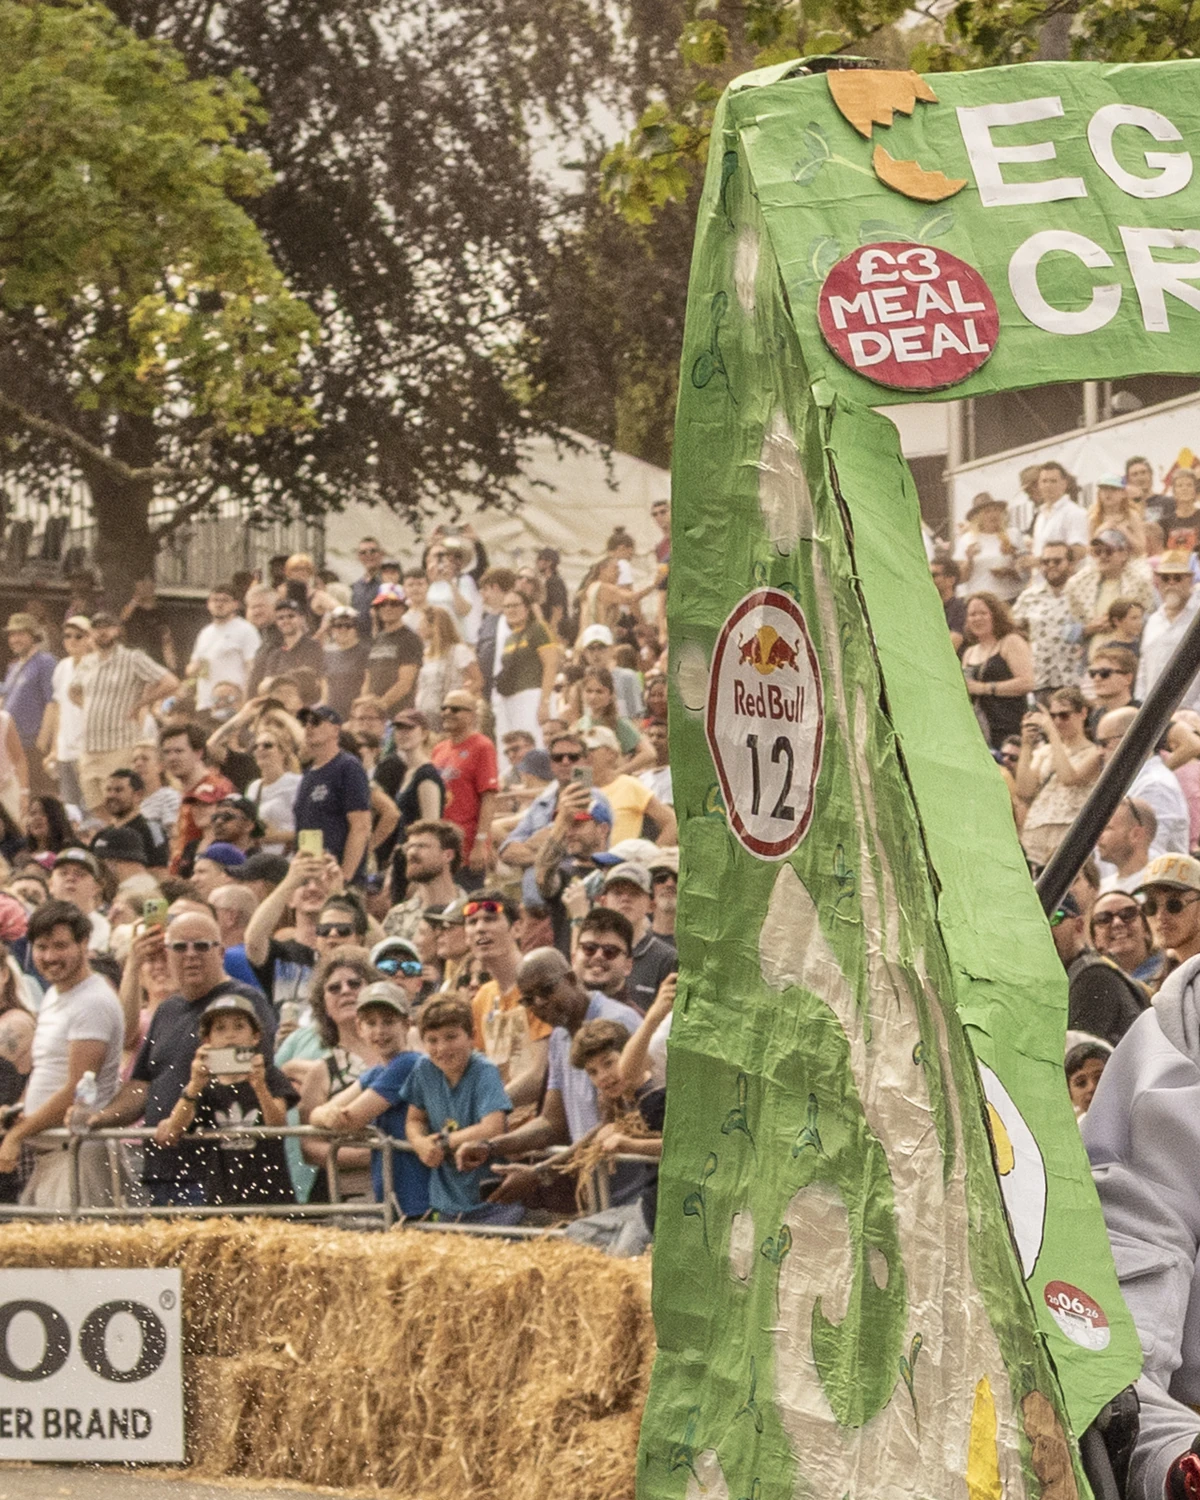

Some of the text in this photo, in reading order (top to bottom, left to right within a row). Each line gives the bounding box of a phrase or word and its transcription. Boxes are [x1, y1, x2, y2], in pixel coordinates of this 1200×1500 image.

[857, 248, 940, 284] £3
[829, 280, 985, 329] MEAL
[847, 319, 990, 367] DEAL
[734, 680, 804, 723] Red Bull
[746, 734, 795, 821] 12
[1058, 1292, 1085, 1314] 06
[44, 1408, 152, 1440] BRAND
